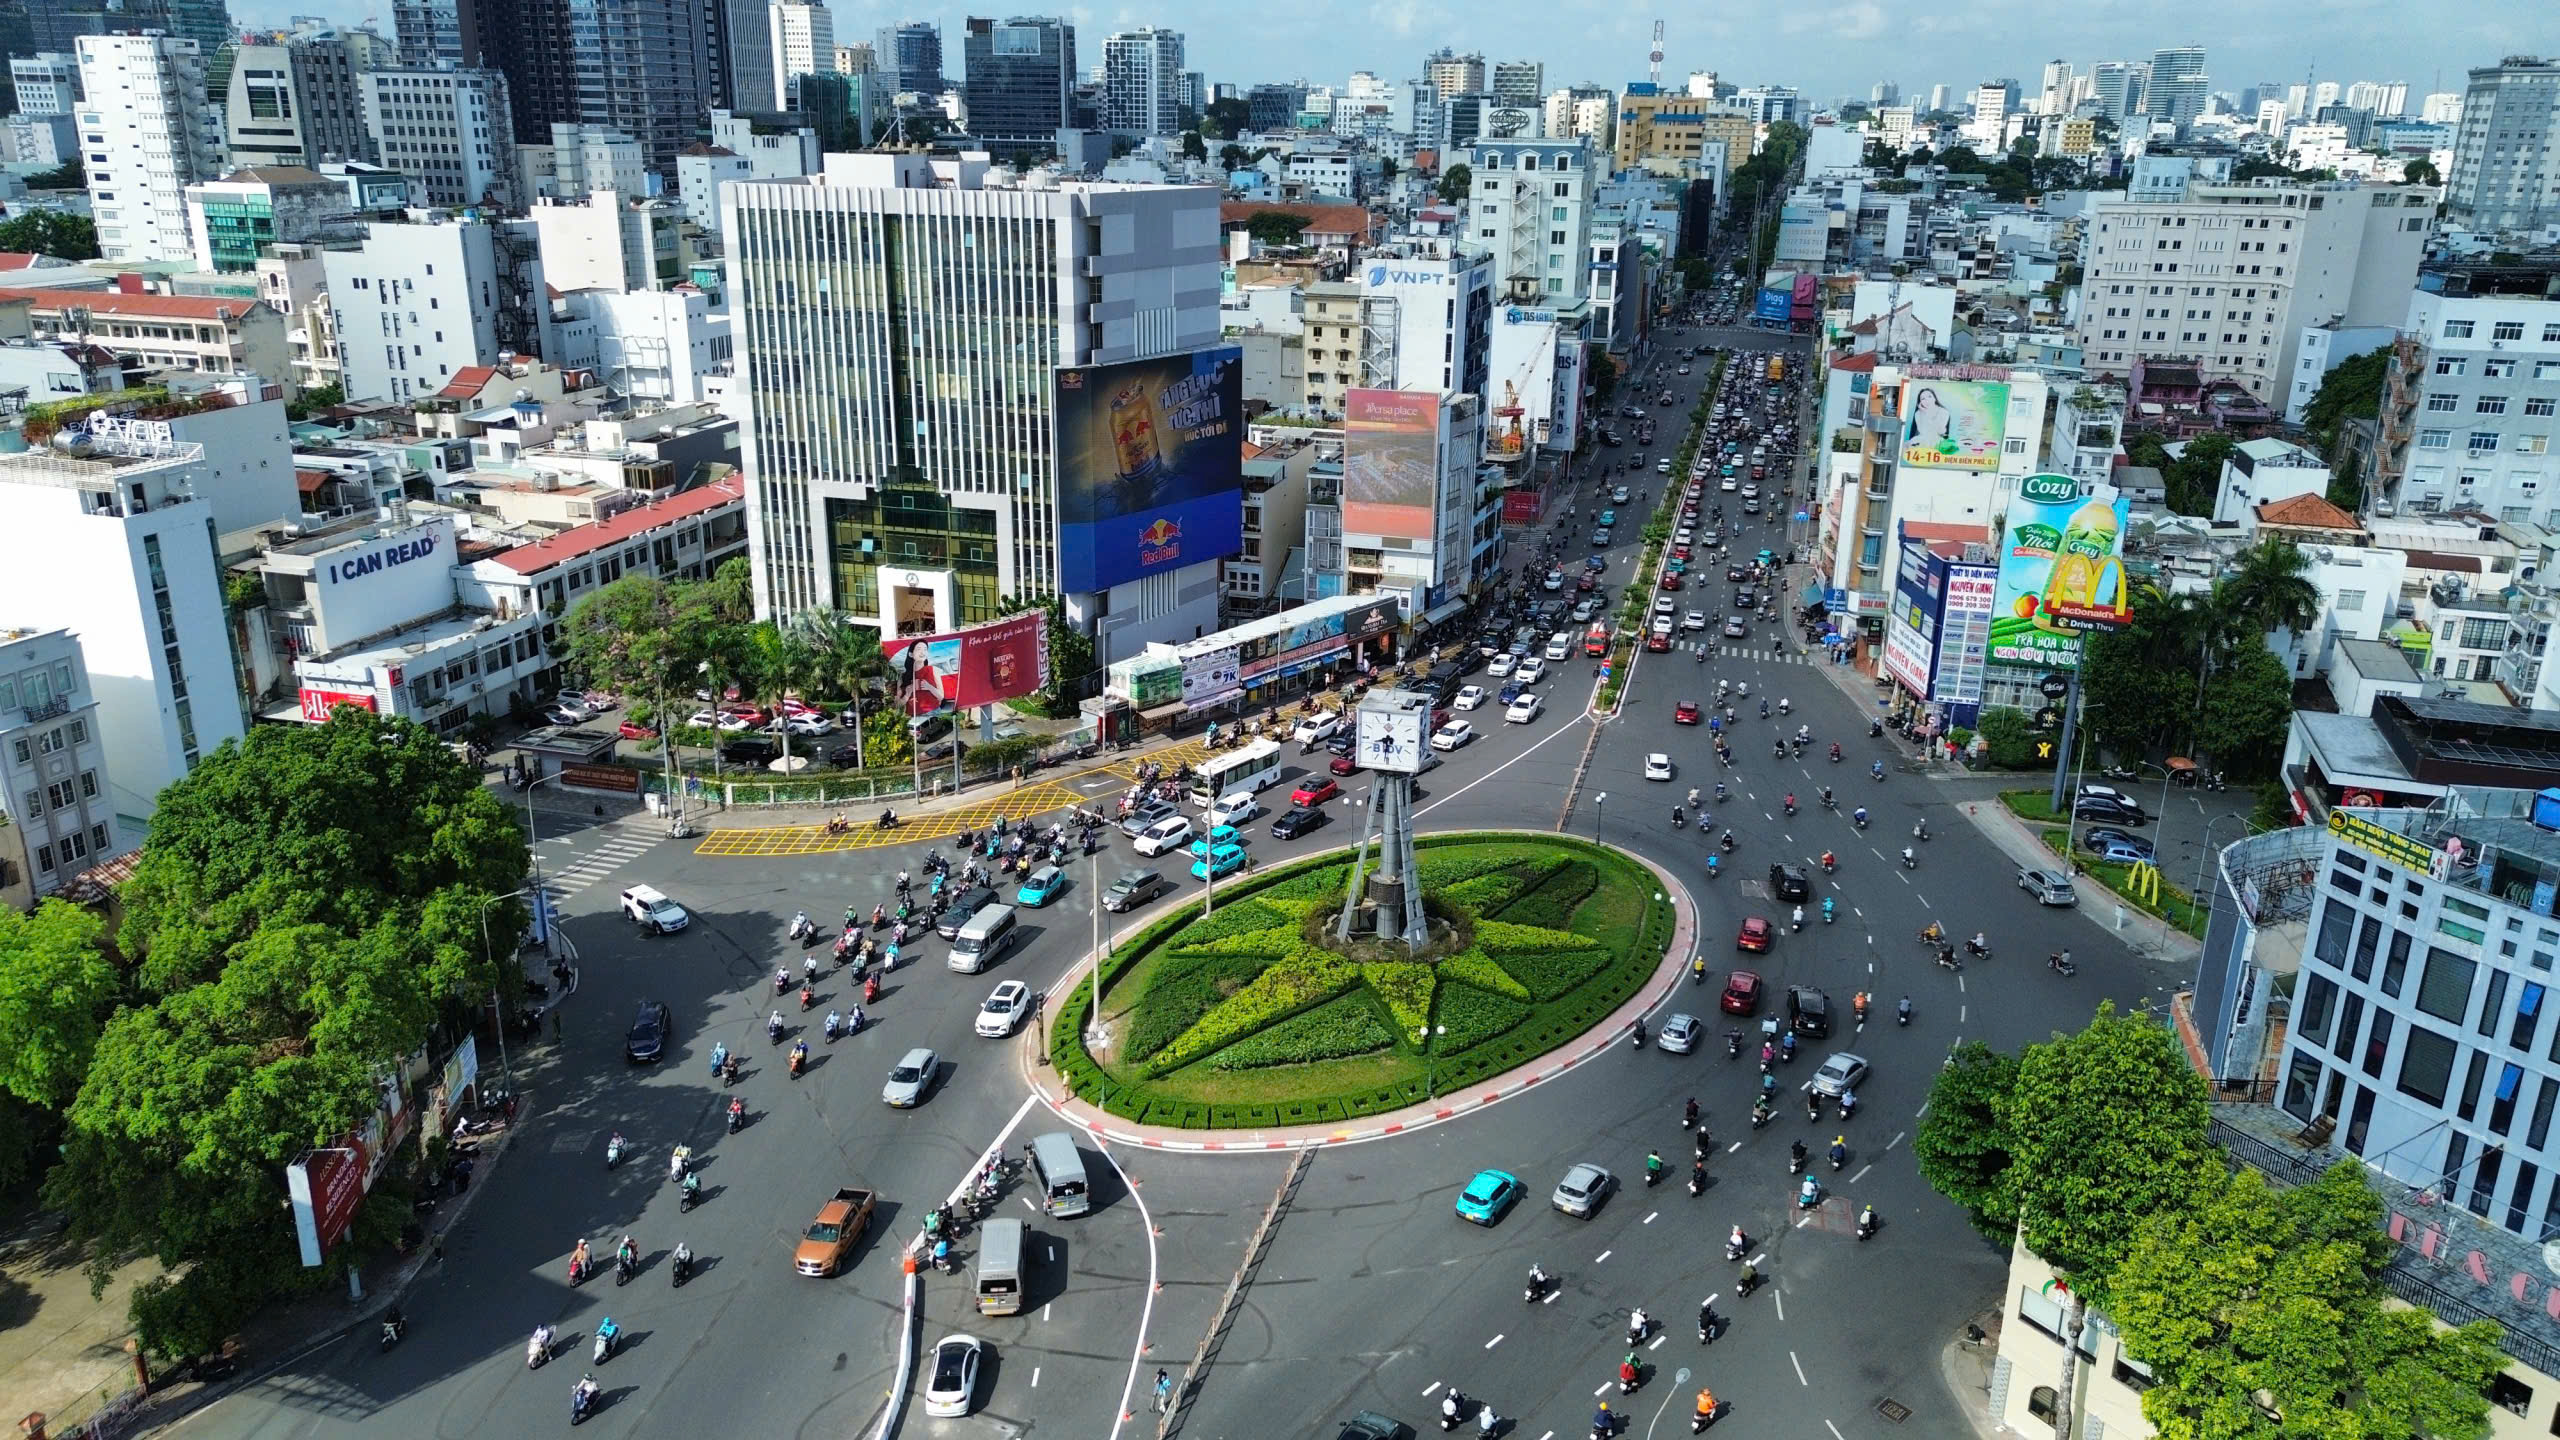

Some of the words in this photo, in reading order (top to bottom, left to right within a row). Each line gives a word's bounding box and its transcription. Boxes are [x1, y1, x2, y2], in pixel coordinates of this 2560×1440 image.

[1389, 271, 1445, 285] VNPT
[1394, 405, 1419, 417] place
[1905, 450, 1942, 464] 14-16
[2026, 478, 2074, 499] Cozy
[1141, 547, 1160, 567] Red
[1160, 542, 1180, 561] Bull
[2069, 542, 2101, 558] Cozy
[329, 565, 339, 585] I
[342, 551, 383, 581] CAN
[385, 537, 434, 568] READ
[2059, 606, 2116, 619] McDonald's
[2070, 619, 2094, 630] Drive
[2095, 623, 2114, 632] Thru
[2036, 636, 2058, 649] HOA
[1228, 651, 1240, 661] 7K
[1223, 670, 1238, 683] 7K
